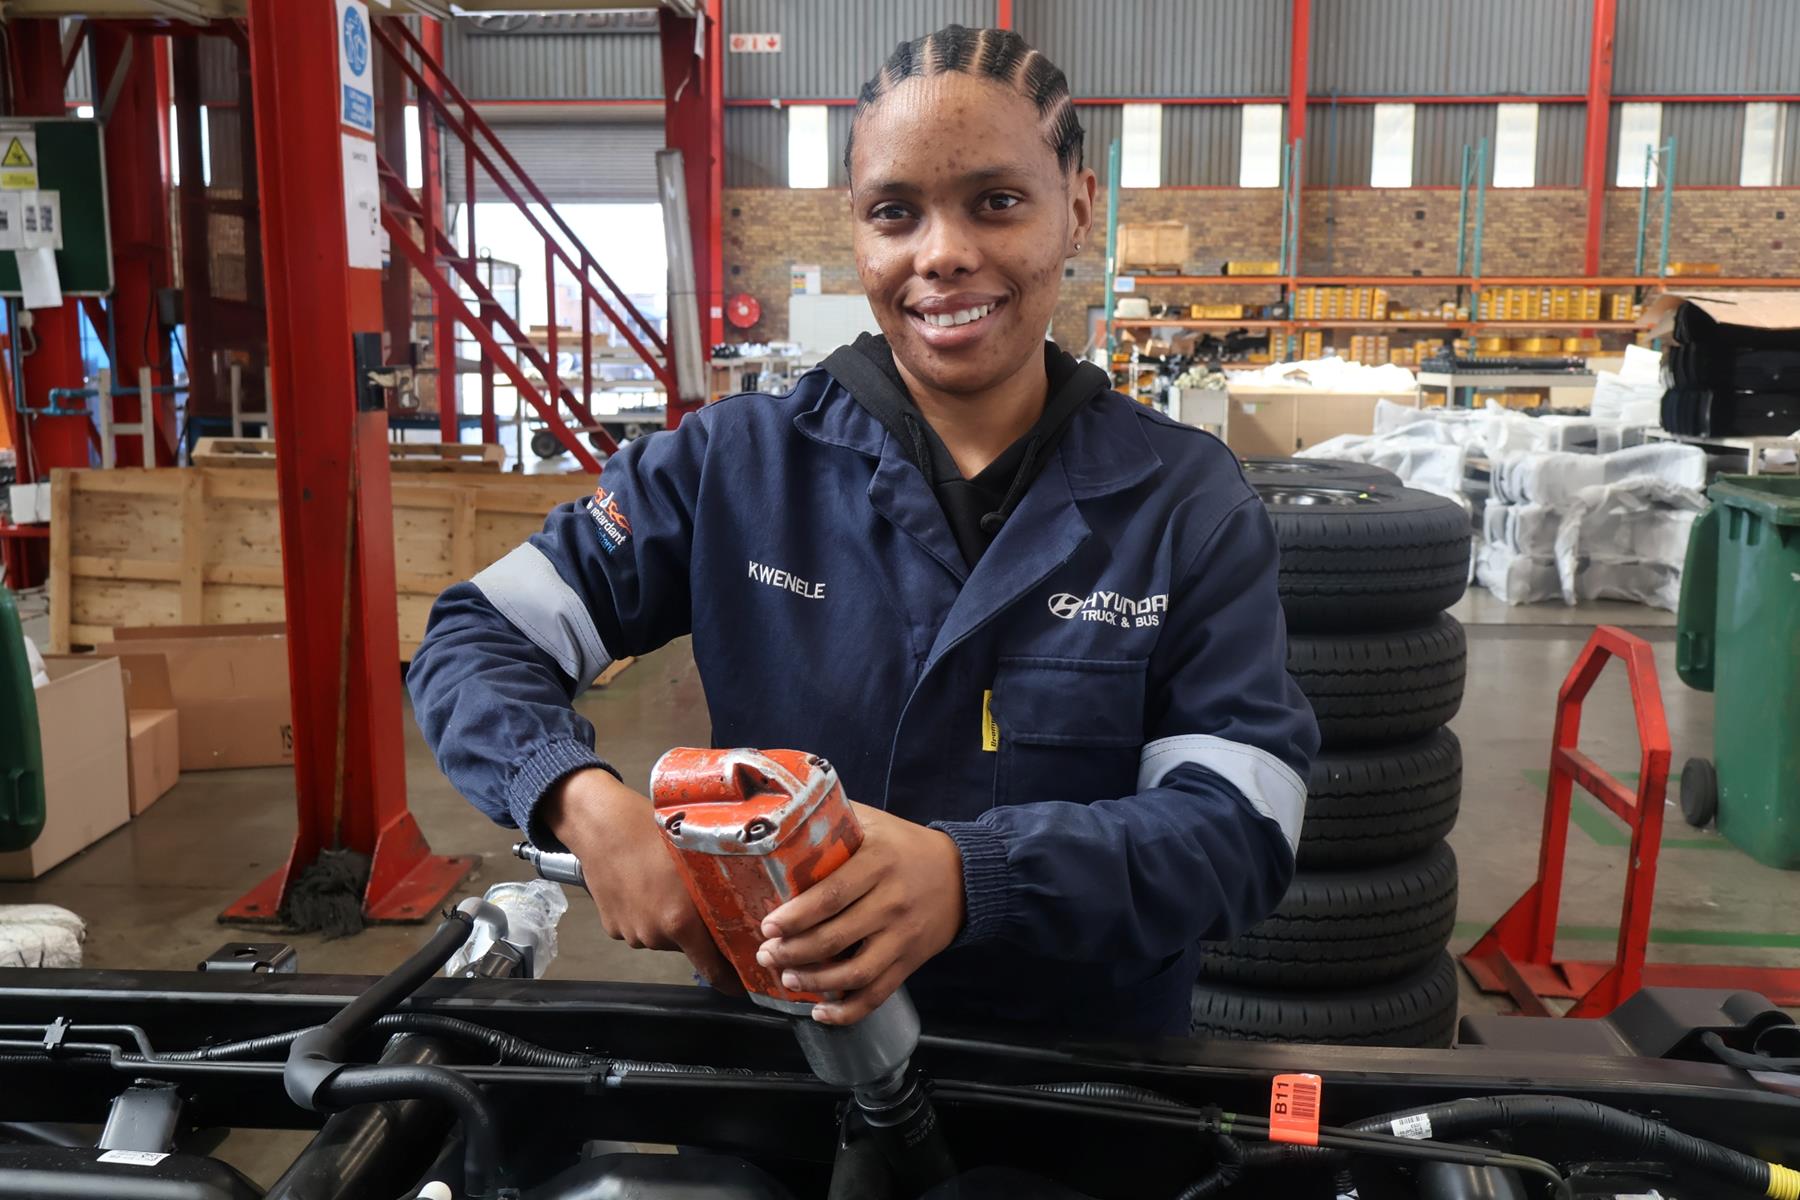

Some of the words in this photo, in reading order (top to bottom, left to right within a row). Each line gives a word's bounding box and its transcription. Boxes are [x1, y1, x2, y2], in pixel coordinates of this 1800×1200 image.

[590, 506, 627, 546] retardant
[748, 560, 826, 599] KWENELE
[1081, 609, 1118, 626] TRUCK
[1120, 616, 1130, 628] &
[1135, 614, 1160, 628] BUS
[1274, 1081, 1289, 1115] B11
